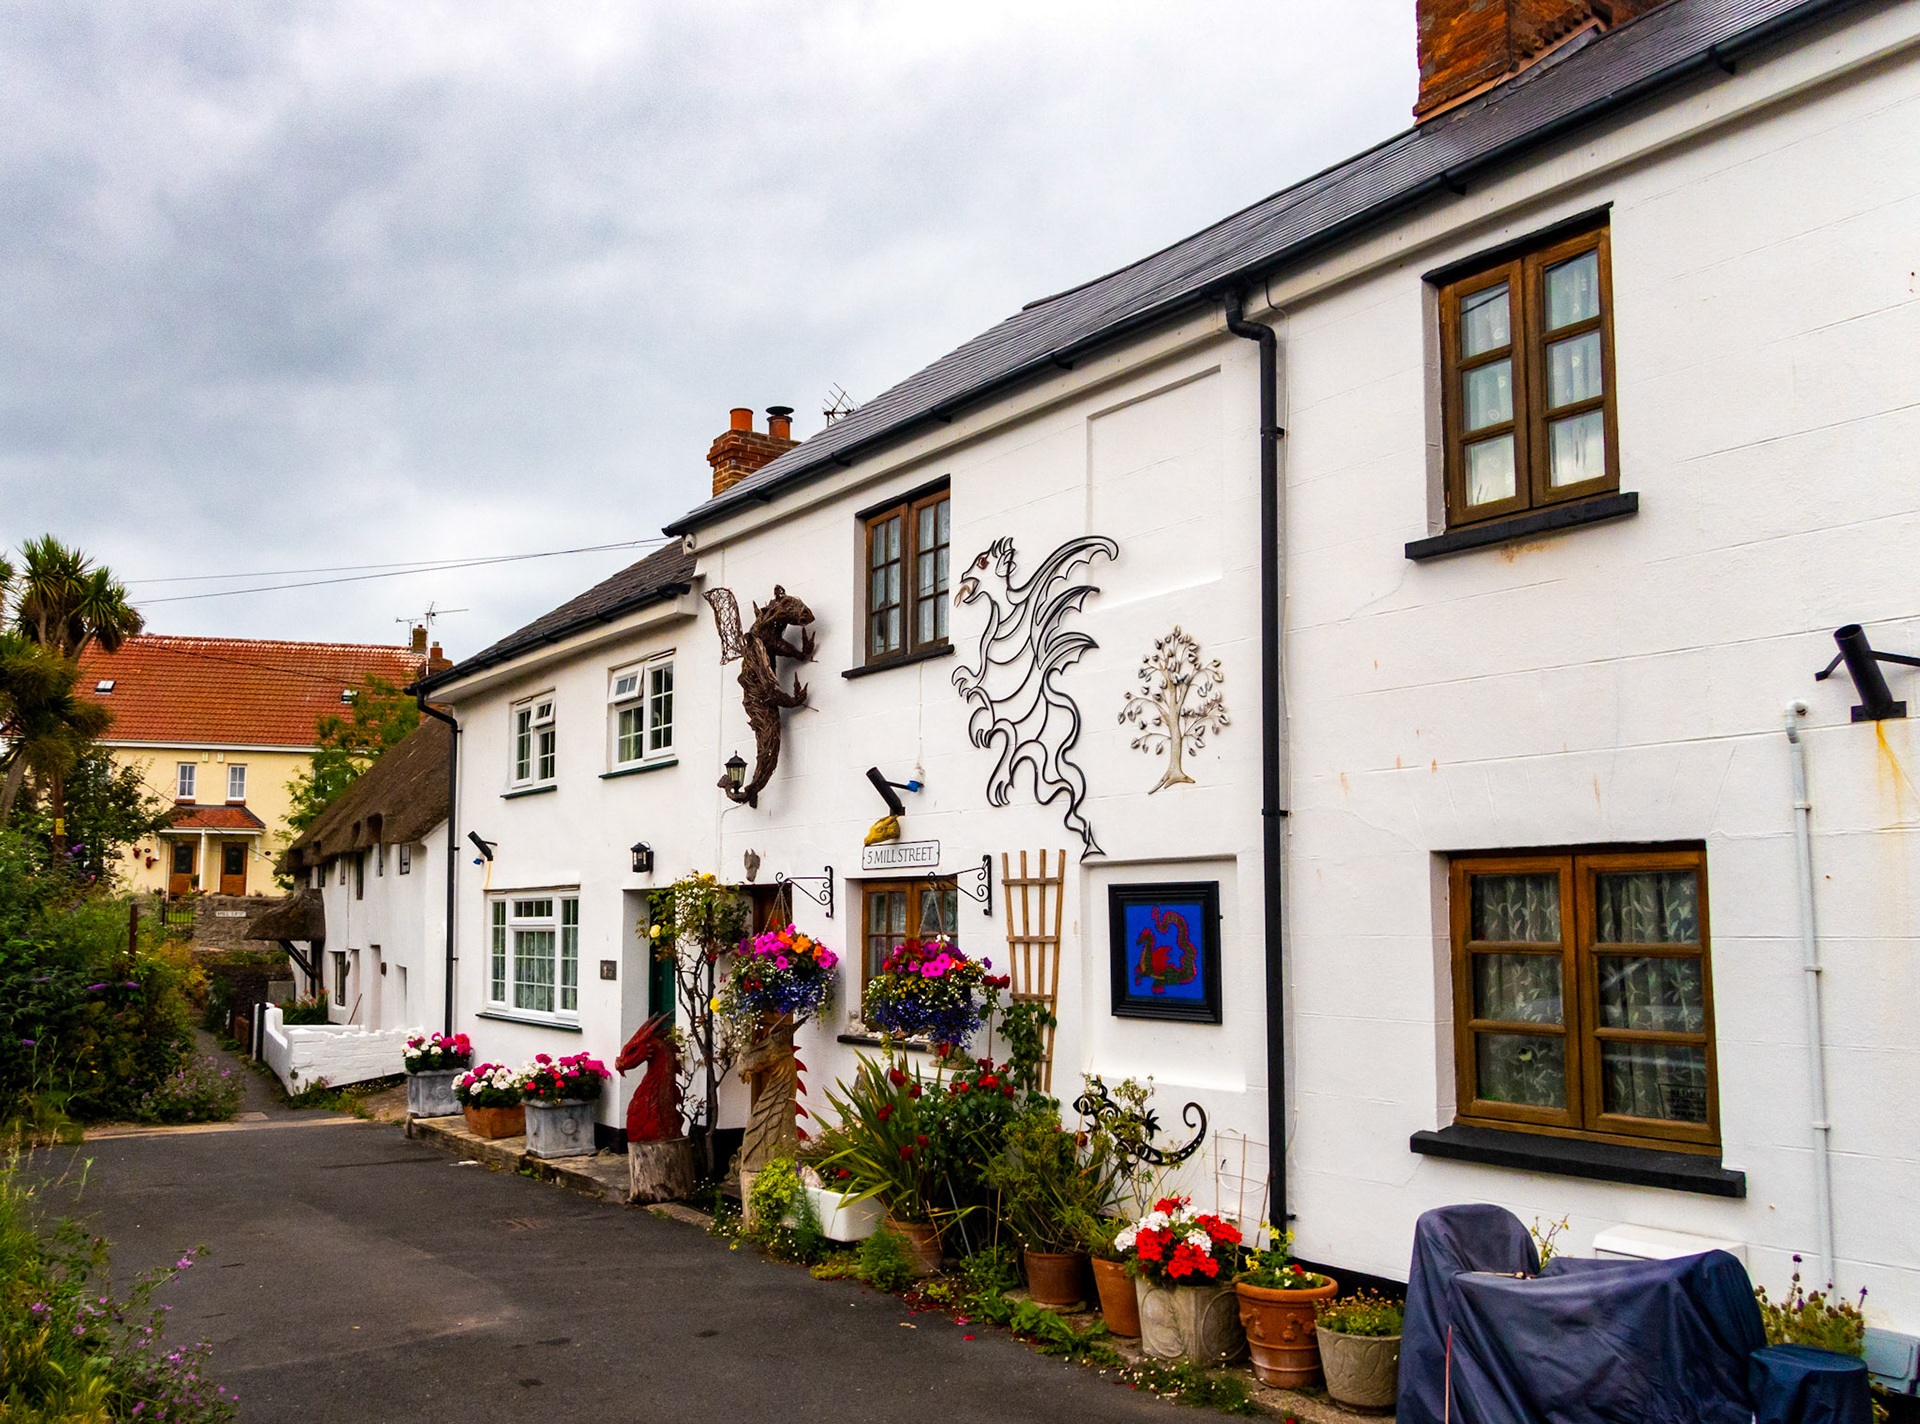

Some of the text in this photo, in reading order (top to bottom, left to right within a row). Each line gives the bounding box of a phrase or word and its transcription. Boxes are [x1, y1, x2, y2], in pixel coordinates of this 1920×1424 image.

[867, 846, 934, 865] 5 MILL STREET
